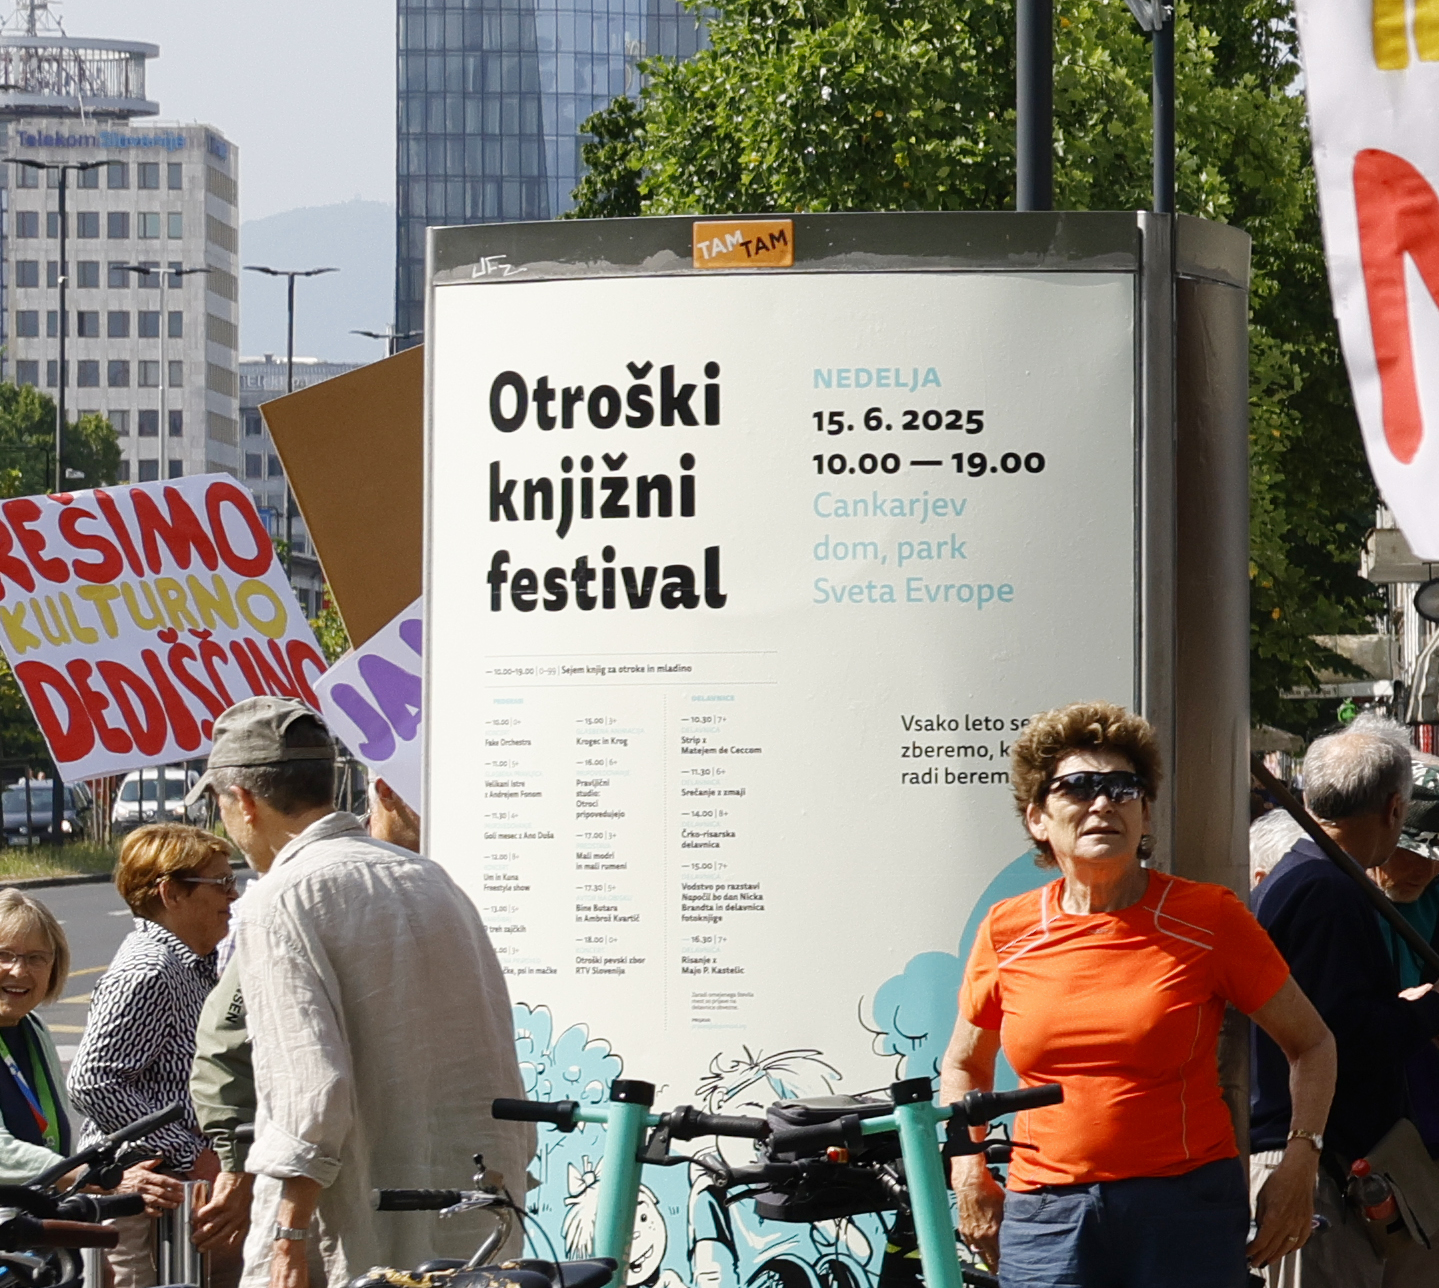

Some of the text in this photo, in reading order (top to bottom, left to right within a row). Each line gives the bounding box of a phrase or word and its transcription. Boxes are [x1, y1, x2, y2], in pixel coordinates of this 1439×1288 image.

[17, 131, 96, 147] Telekom
[697, 228, 788, 261] TAM TAM
[813, 367, 942, 389] NEDELJA
[488, 362, 721, 433] Otroški
[813, 407, 984, 435] 15. 6. 2025
[813, 451, 1045, 476] 10.00 19.00
[488, 453, 696, 539] knjižni
[812, 491, 968, 524] Cankarjev
[812, 534, 967, 569] dom, park
[487, 546, 728, 613] festival
[812, 577, 1015, 610] Sveta Evrope
[0, 573, 288, 655] KULTURNO
[562, 664, 692, 675] Sejem knjig otroke mladino
[901, 715, 959, 732] Vsako
[965, 715, 1004, 731] leto
[682, 736, 700, 745] Strip
[681, 747, 716, 755] Matejem
[901, 742, 1010, 761] zberemo, k
[901, 768, 1009, 784] radi berem
[681, 788, 746, 797] Srečanje zmaji
[681, 841, 720, 849] delavnica
[691, 863, 712, 871] 15.00
[682, 882, 760, 891] Vodstvo razstavi
[724, 893, 738, 901] dan
[740, 892, 763, 901] Nicka
[682, 903, 764, 911] Brandta delavnica
[681, 914, 723, 923] fotoknjige
[682, 956, 711, 965] Risanje
[682, 966, 745, 976] Majo Kastelic
[225, 984, 244, 1024] SEN
